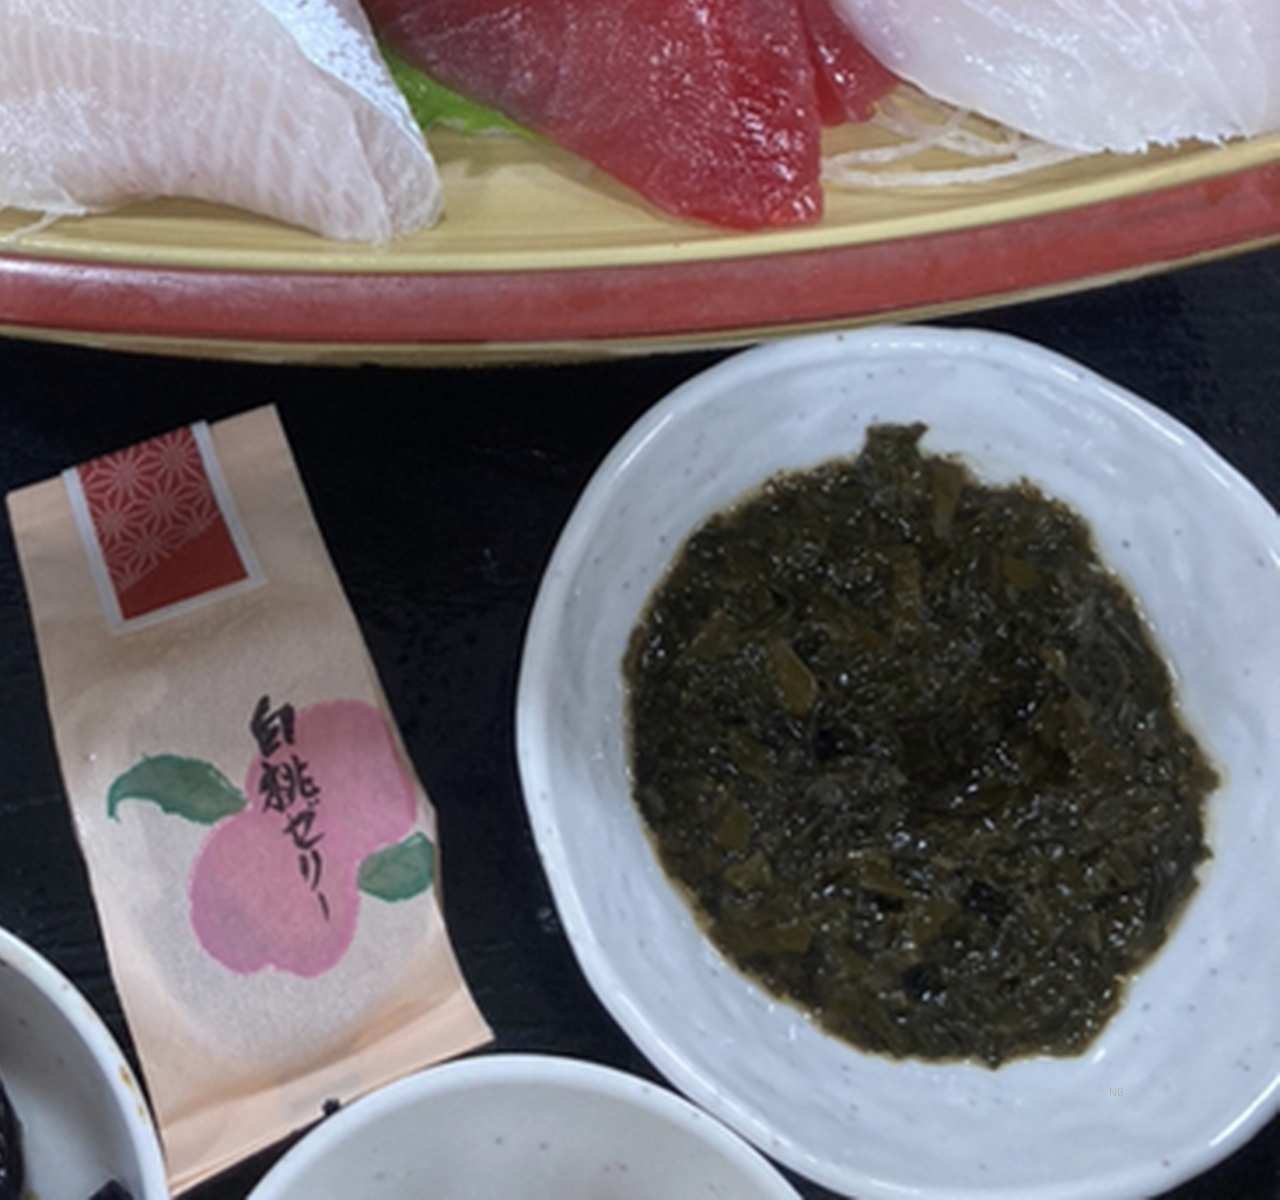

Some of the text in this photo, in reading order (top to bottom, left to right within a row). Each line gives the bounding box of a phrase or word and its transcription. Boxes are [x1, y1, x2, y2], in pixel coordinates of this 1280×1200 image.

[249, 694, 331, 922] 白桃ゼリー
